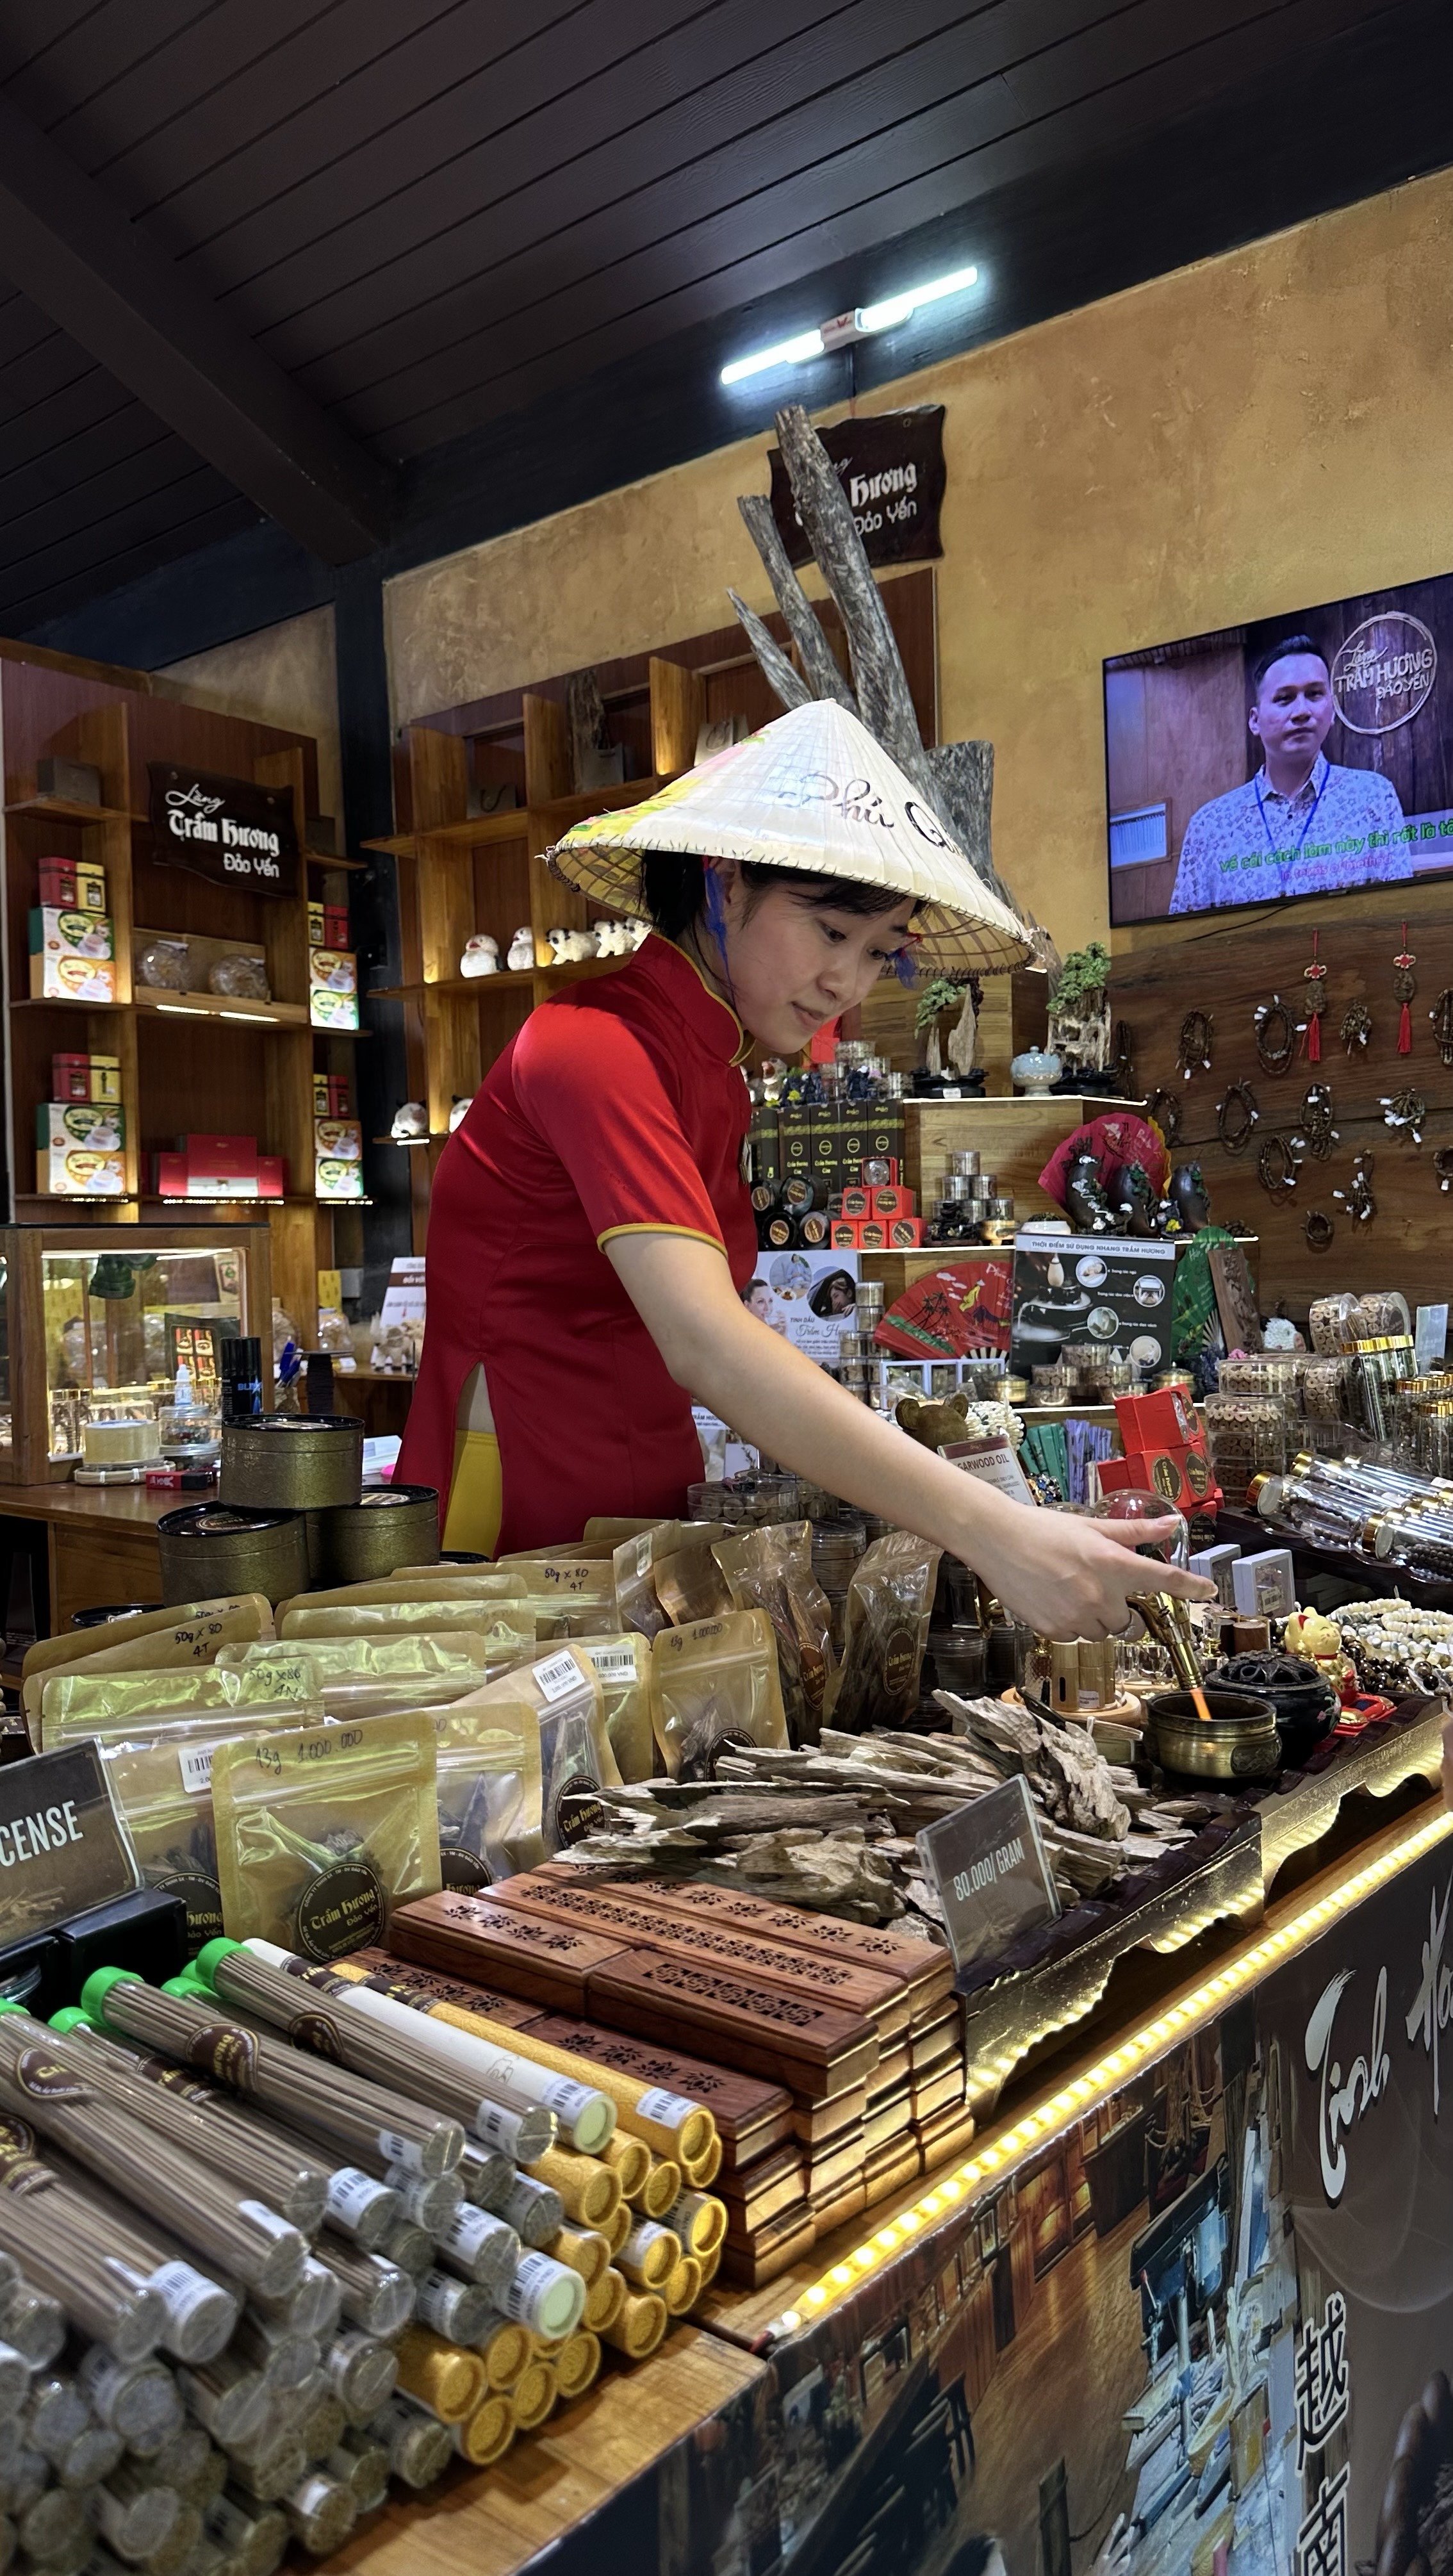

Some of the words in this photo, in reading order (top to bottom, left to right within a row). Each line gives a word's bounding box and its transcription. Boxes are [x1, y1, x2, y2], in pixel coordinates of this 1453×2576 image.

[165, 783, 226, 814] Làng
[220, 817, 281, 857] Hương
[224, 852, 251, 873] Đảo
[253, 857, 280, 878] Yến
[996, 1454, 1010, 1464] OIL
[208, 1623, 222, 1634] 80
[256, 1747, 282, 1775] 13g
[953, 1851, 998, 1901] 80.000/
[996, 1837, 1025, 1874] GRAM
